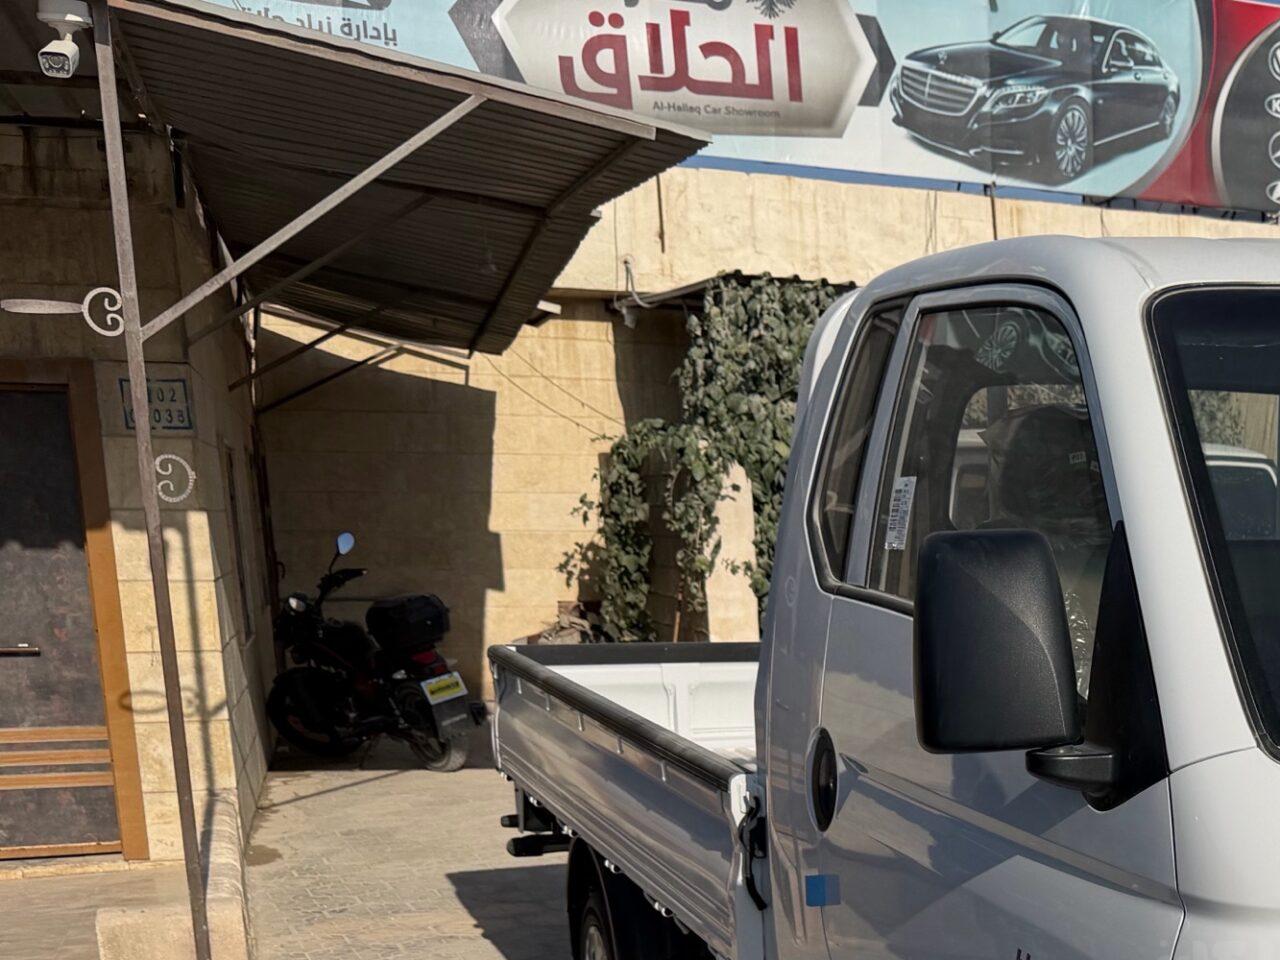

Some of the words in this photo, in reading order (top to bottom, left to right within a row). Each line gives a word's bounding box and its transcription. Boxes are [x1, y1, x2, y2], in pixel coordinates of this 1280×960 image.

[558, 9, 803, 110] الحلاق
[703, 104, 722, 115] Car
[724, 105, 780, 118] Showroom
